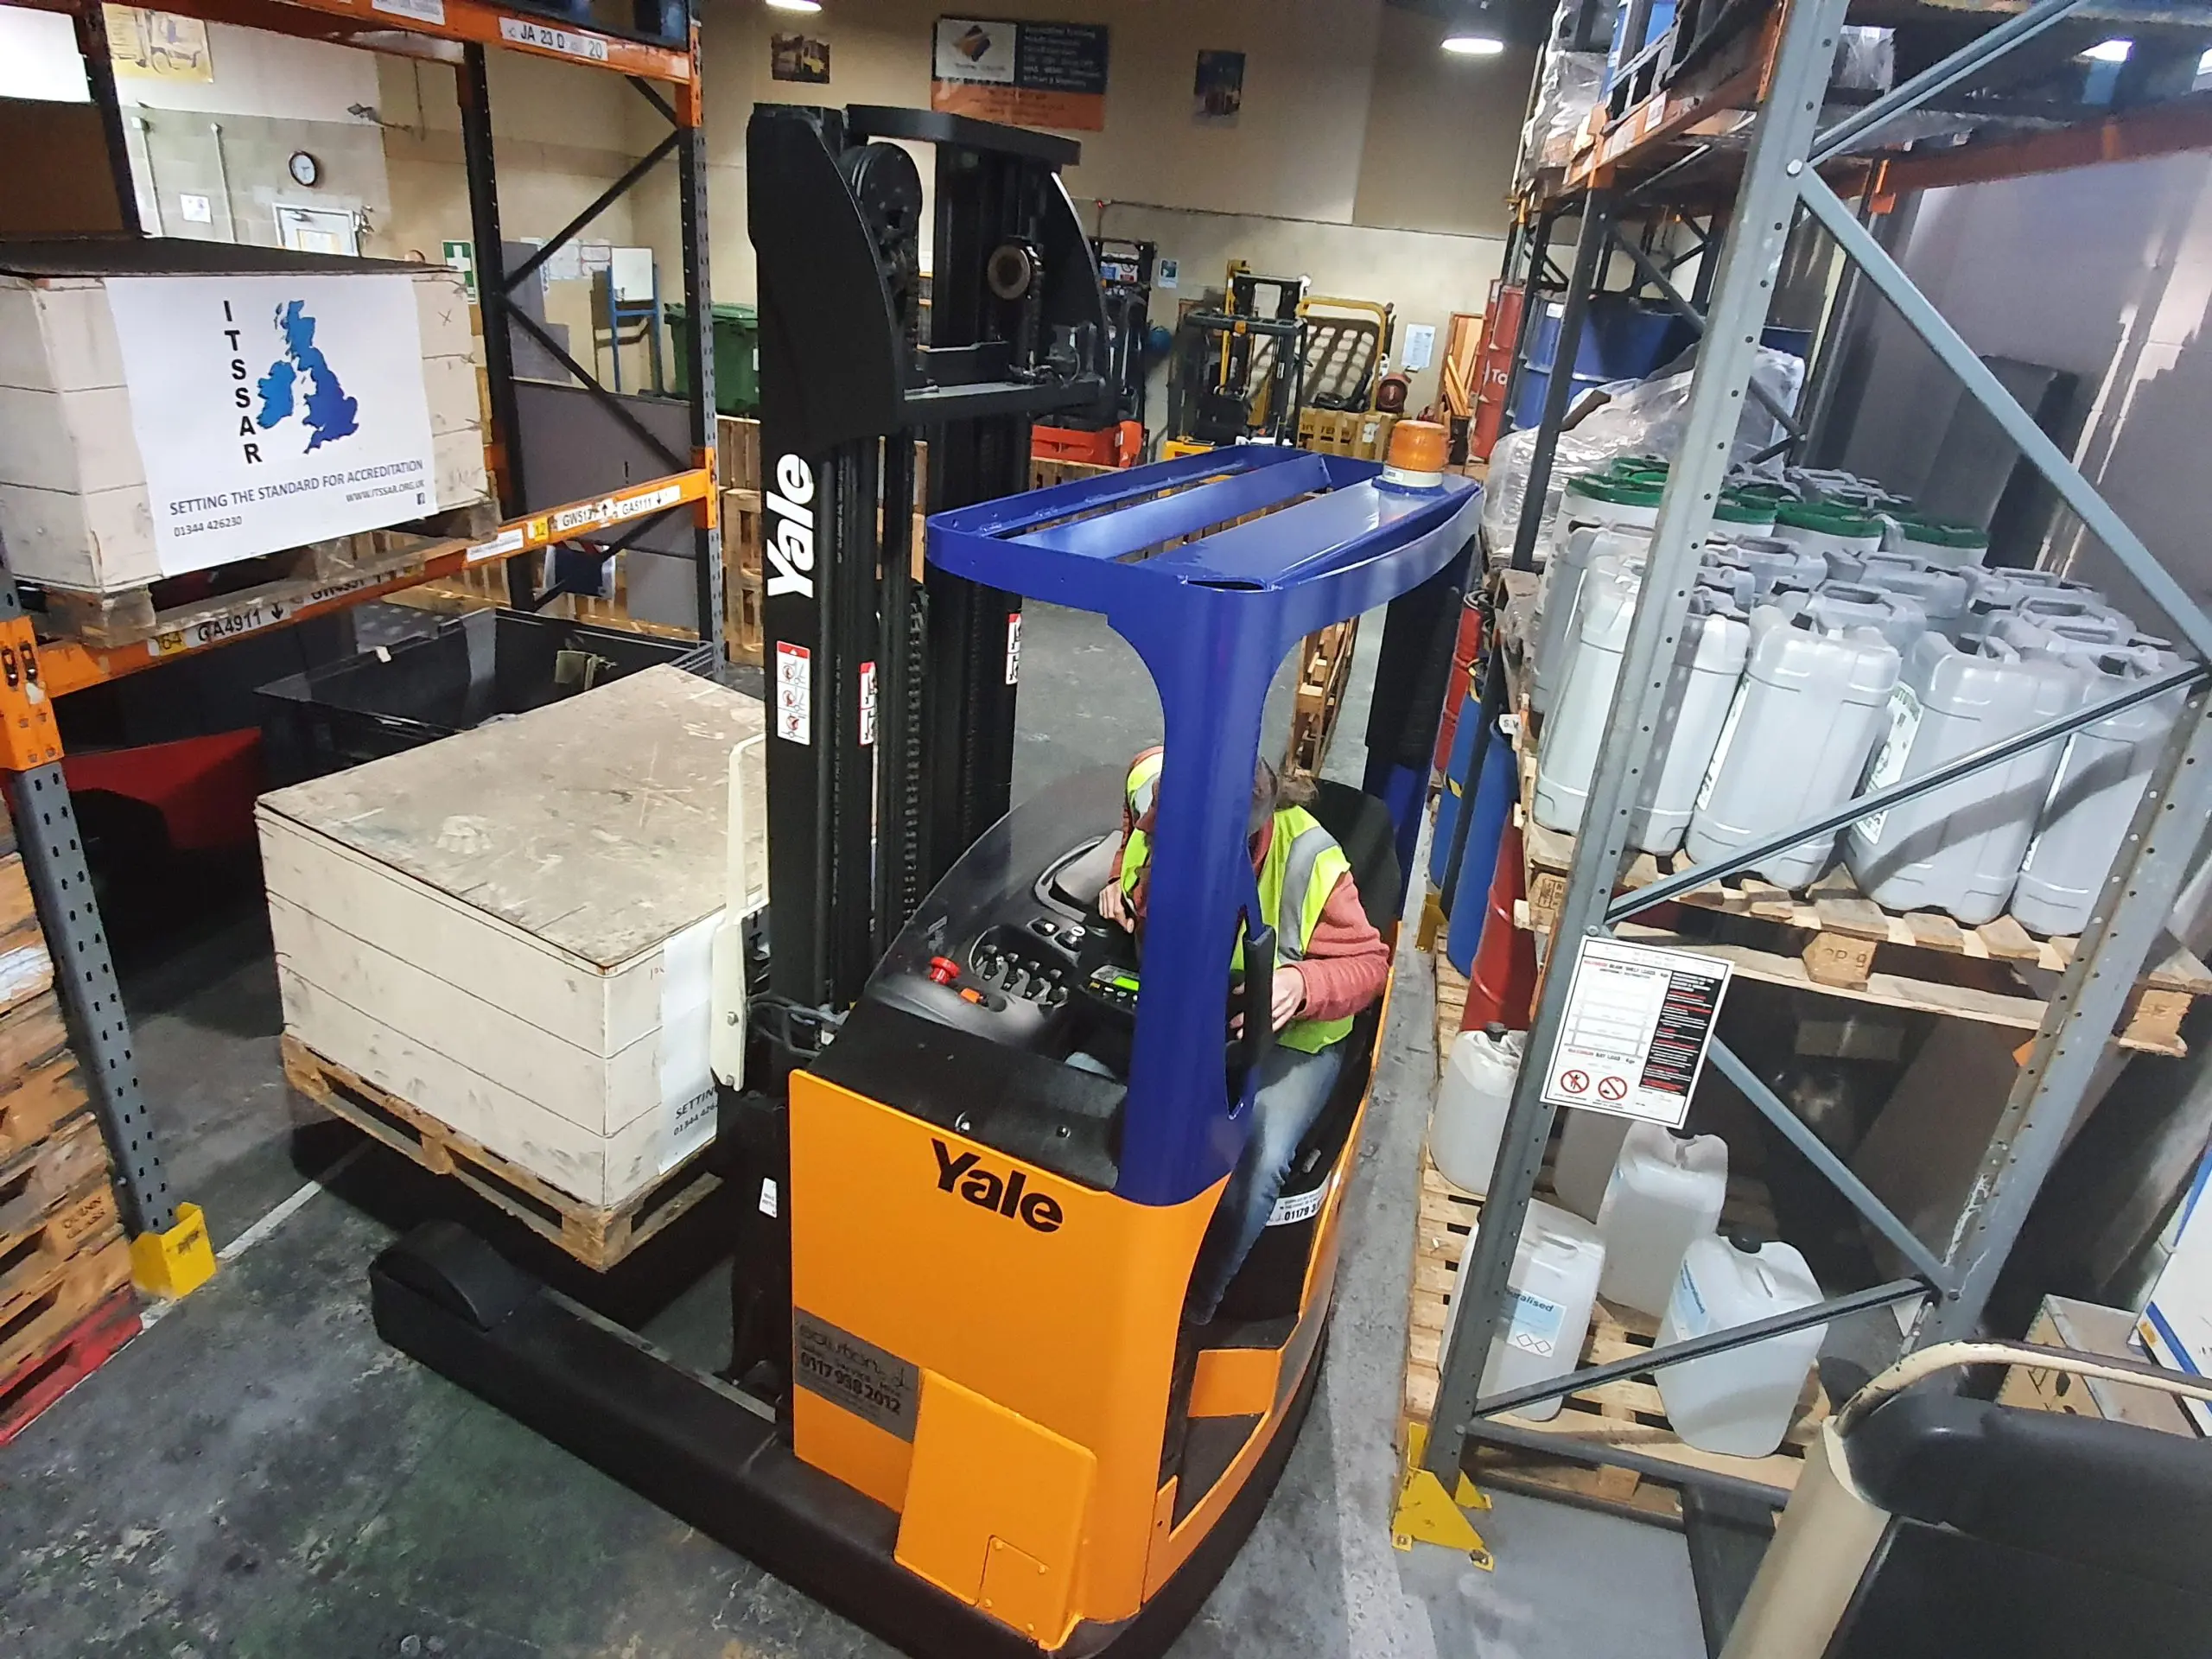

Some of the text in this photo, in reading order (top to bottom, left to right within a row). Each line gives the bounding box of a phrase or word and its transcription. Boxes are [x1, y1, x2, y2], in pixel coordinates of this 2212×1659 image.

[521, 24, 535, 41] JA
[588, 40, 603, 58] 20
[224, 300, 263, 464] ITSSAR
[169, 459, 423, 516] SETTING THE STANDARD FOR ACCREDITATION
[174, 516, 243, 537] 01344 426230
[766, 454, 815, 598] Yale
[198, 607, 262, 641] GA4911
[675, 1086, 715, 1120] SETTIN
[931, 1137, 1064, 1233] Yale
